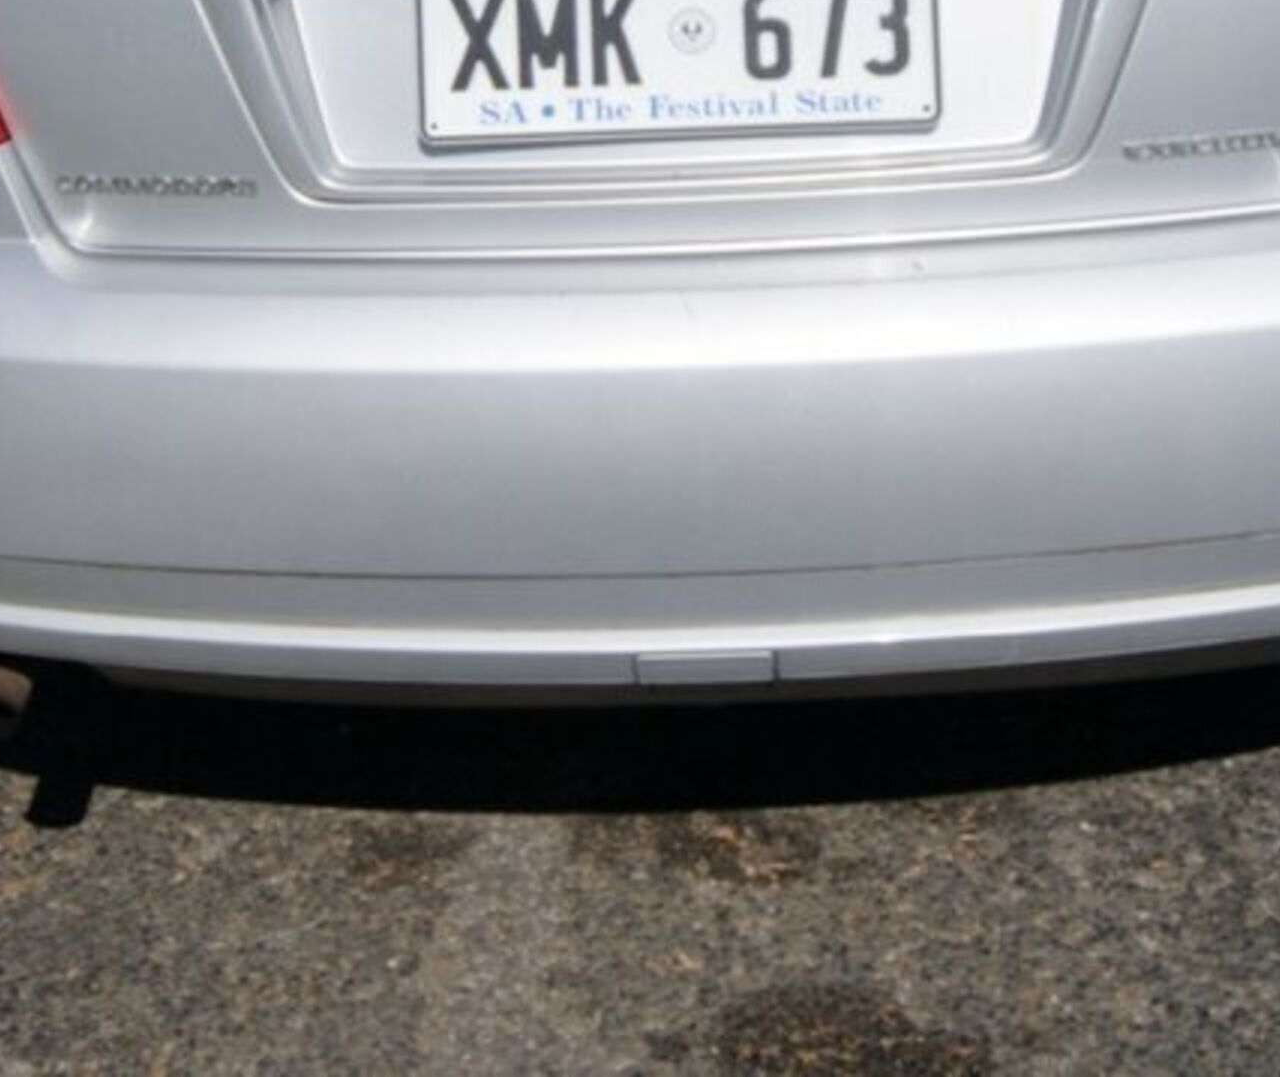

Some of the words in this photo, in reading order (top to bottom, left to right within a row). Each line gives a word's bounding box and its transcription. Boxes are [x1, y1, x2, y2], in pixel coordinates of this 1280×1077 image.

[479, 101, 527, 123] SA
[568, 98, 632, 122] The
[649, 90, 778, 119] Festival
[796, 89, 882, 113] State
